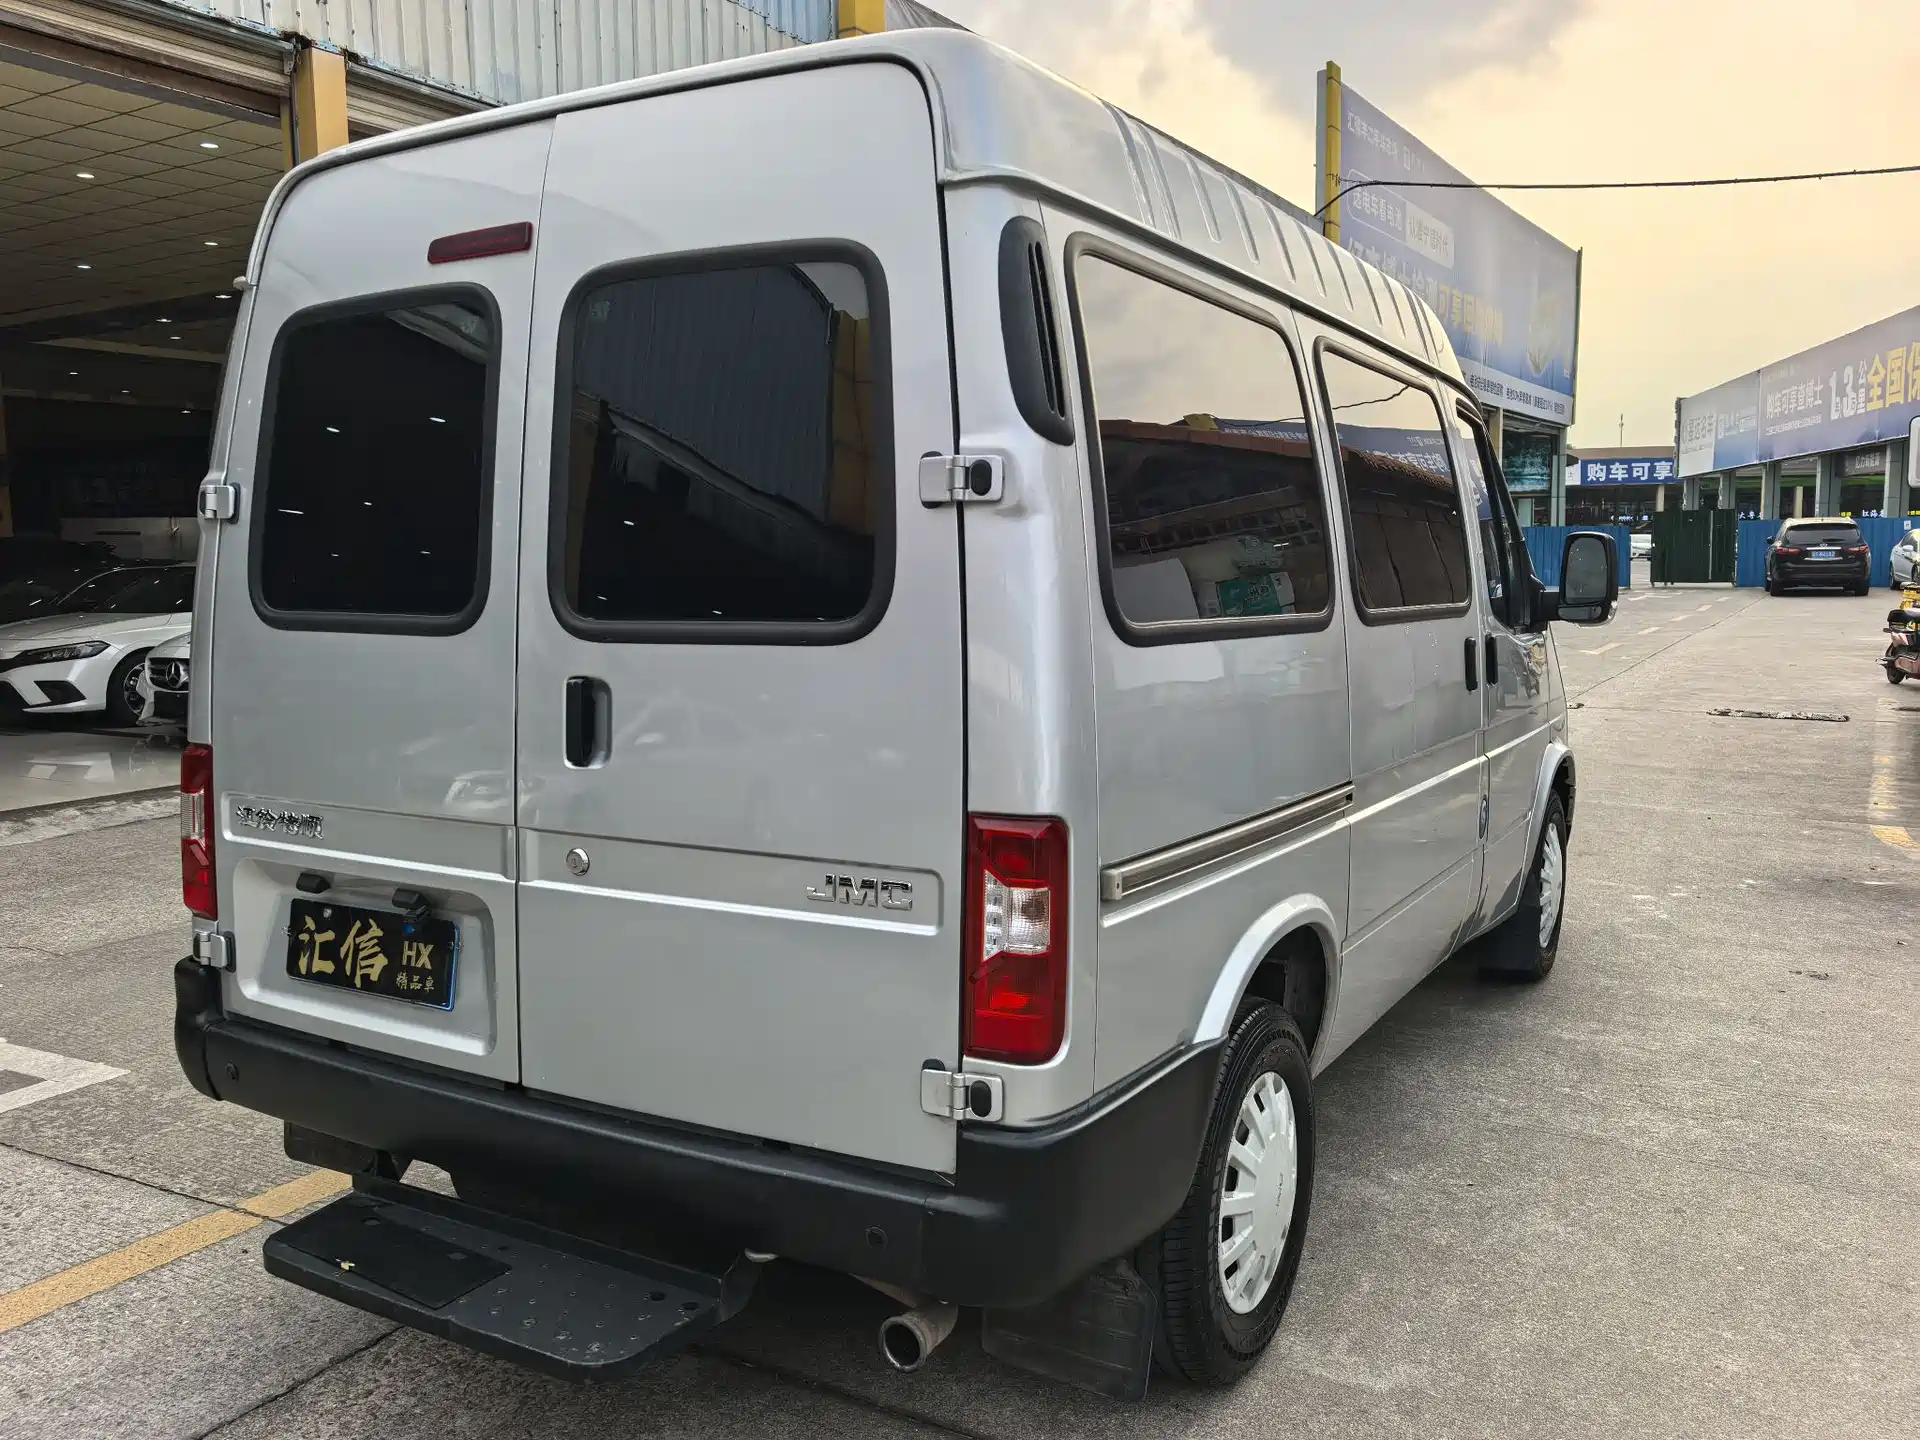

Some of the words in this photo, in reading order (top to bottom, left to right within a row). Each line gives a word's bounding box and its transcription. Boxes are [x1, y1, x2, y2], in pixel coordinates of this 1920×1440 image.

[1587, 461, 1673, 481] 购车可享
[806, 873, 913, 911] JMC
[298, 915, 389, 988] 汇信
[402, 940, 434, 970] HX
